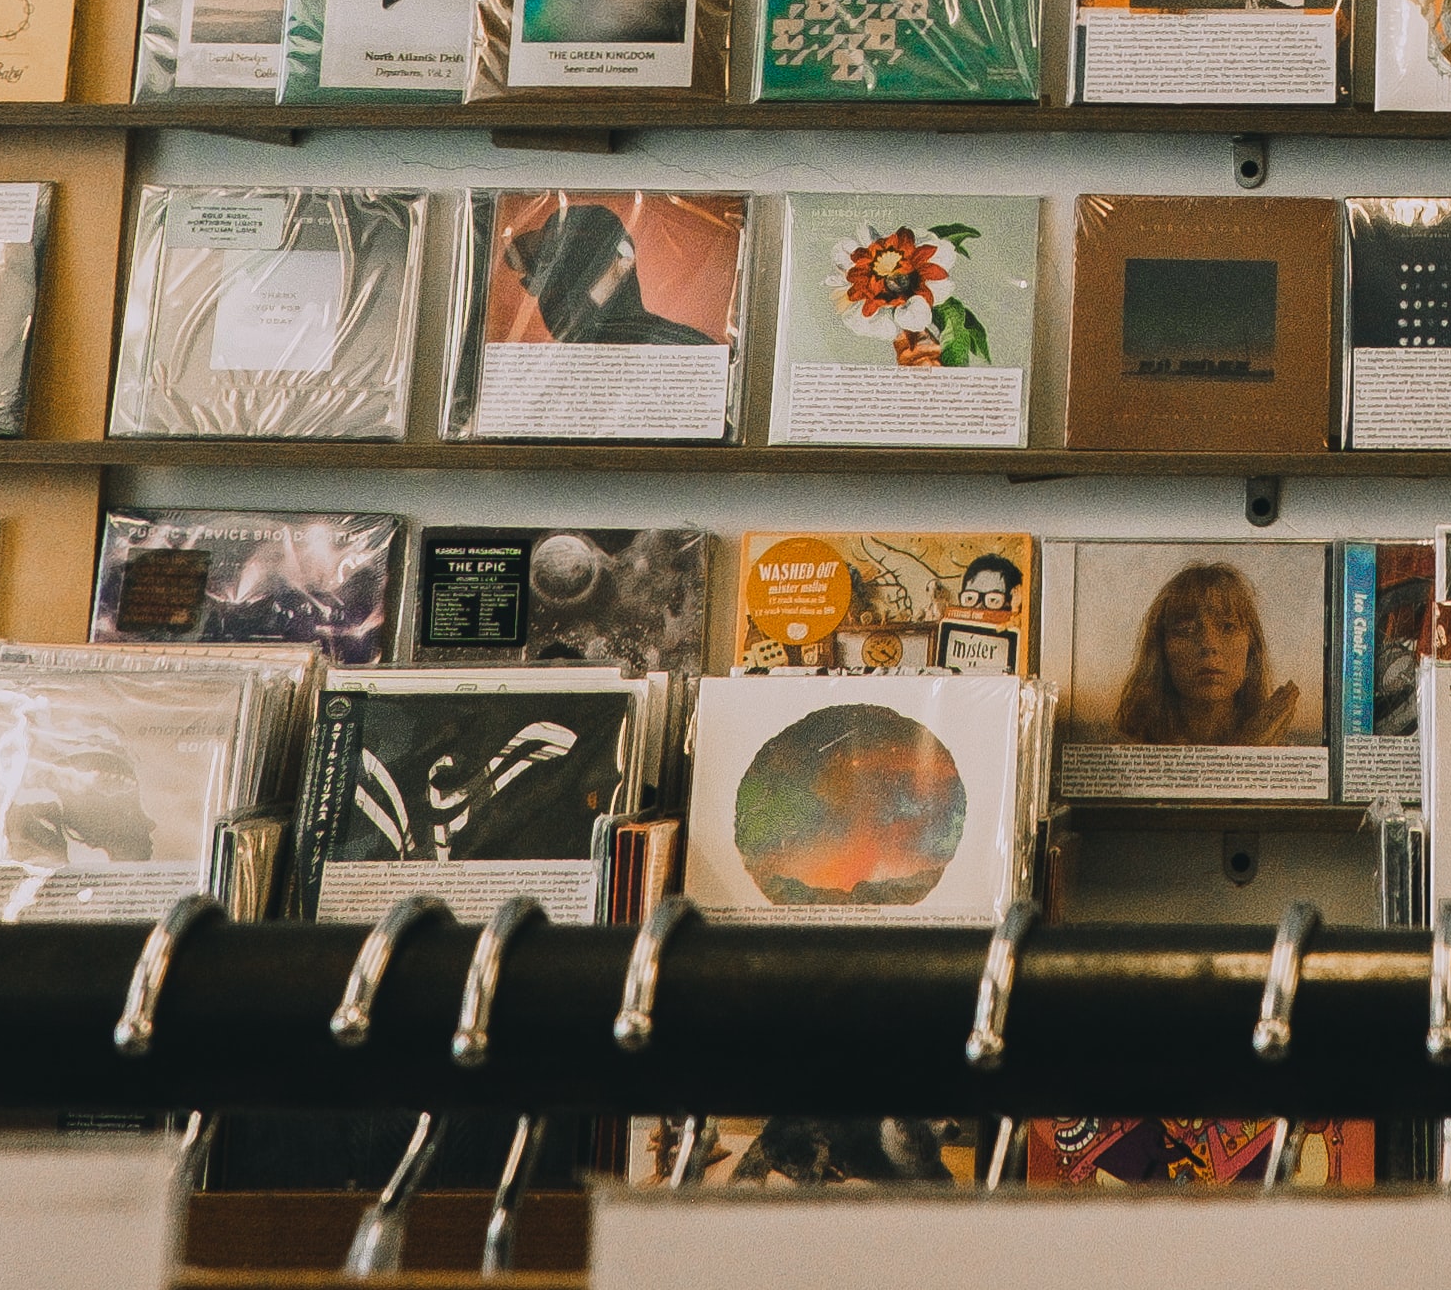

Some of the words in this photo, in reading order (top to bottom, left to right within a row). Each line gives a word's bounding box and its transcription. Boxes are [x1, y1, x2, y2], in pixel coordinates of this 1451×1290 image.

[365, 50, 395, 62] North
[397, 50, 437, 62] Atlantic
[548, 50, 566, 61] THE
[568, 50, 604, 61] GREEN
[605, 50, 656, 61] KINGDOM
[563, 64, 586, 75] Seen
[586, 64, 604, 75] and
[605, 64, 639, 75] Unseen
[255, 304, 276, 312] YOU
[279, 304, 301, 312] FOR
[259, 317, 294, 326] TODAY
[449, 561, 474, 573] THE
[477, 561, 507, 573] EPIC
[759, 561, 814, 582] WASHED
[815, 561, 840, 579] OUT
[768, 581, 799, 595] mister
[951, 635, 999, 662] mister
